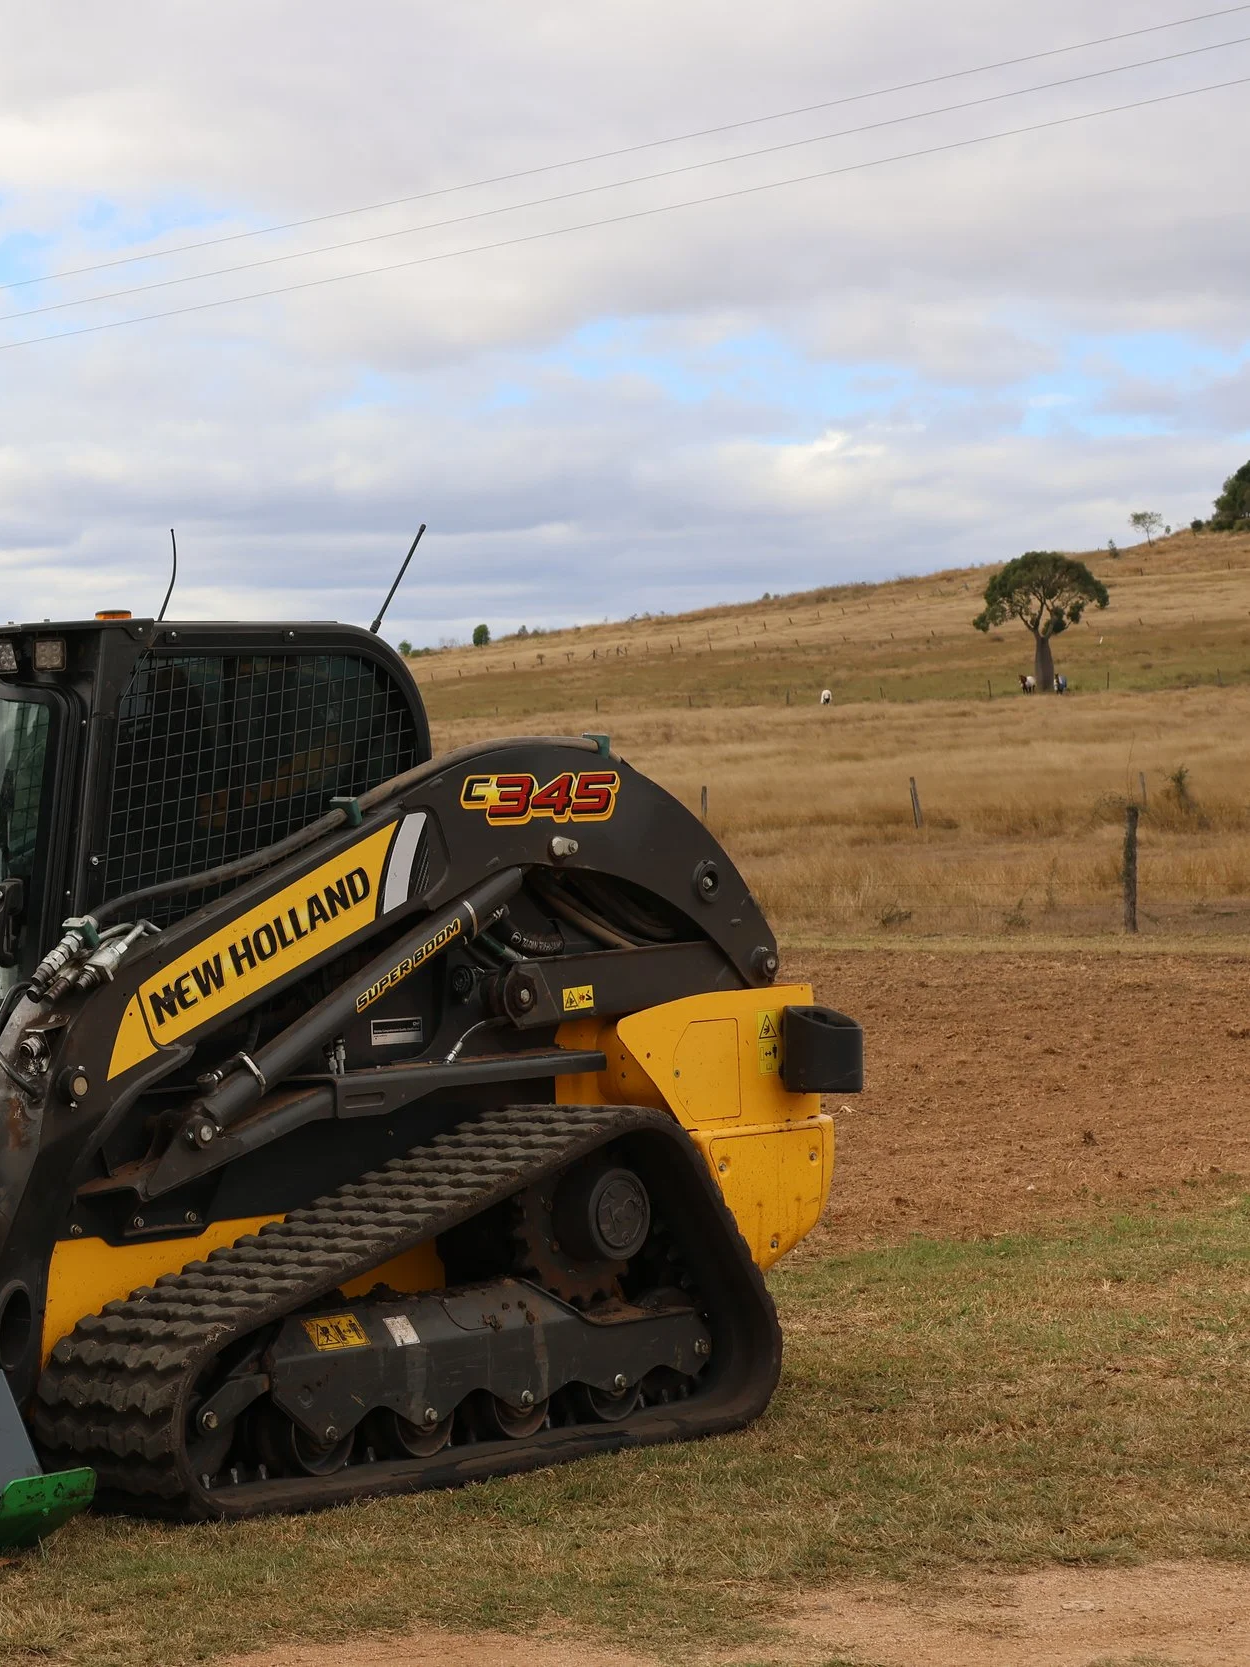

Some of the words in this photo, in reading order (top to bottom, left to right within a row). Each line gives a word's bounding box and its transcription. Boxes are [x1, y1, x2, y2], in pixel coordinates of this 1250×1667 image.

[461, 771, 620, 825] C345
[148, 952, 226, 1027] NEW
[228, 866, 371, 978] HOLLAND
[356, 958, 412, 1013] SUPER
[413, 918, 461, 967] BOOM
